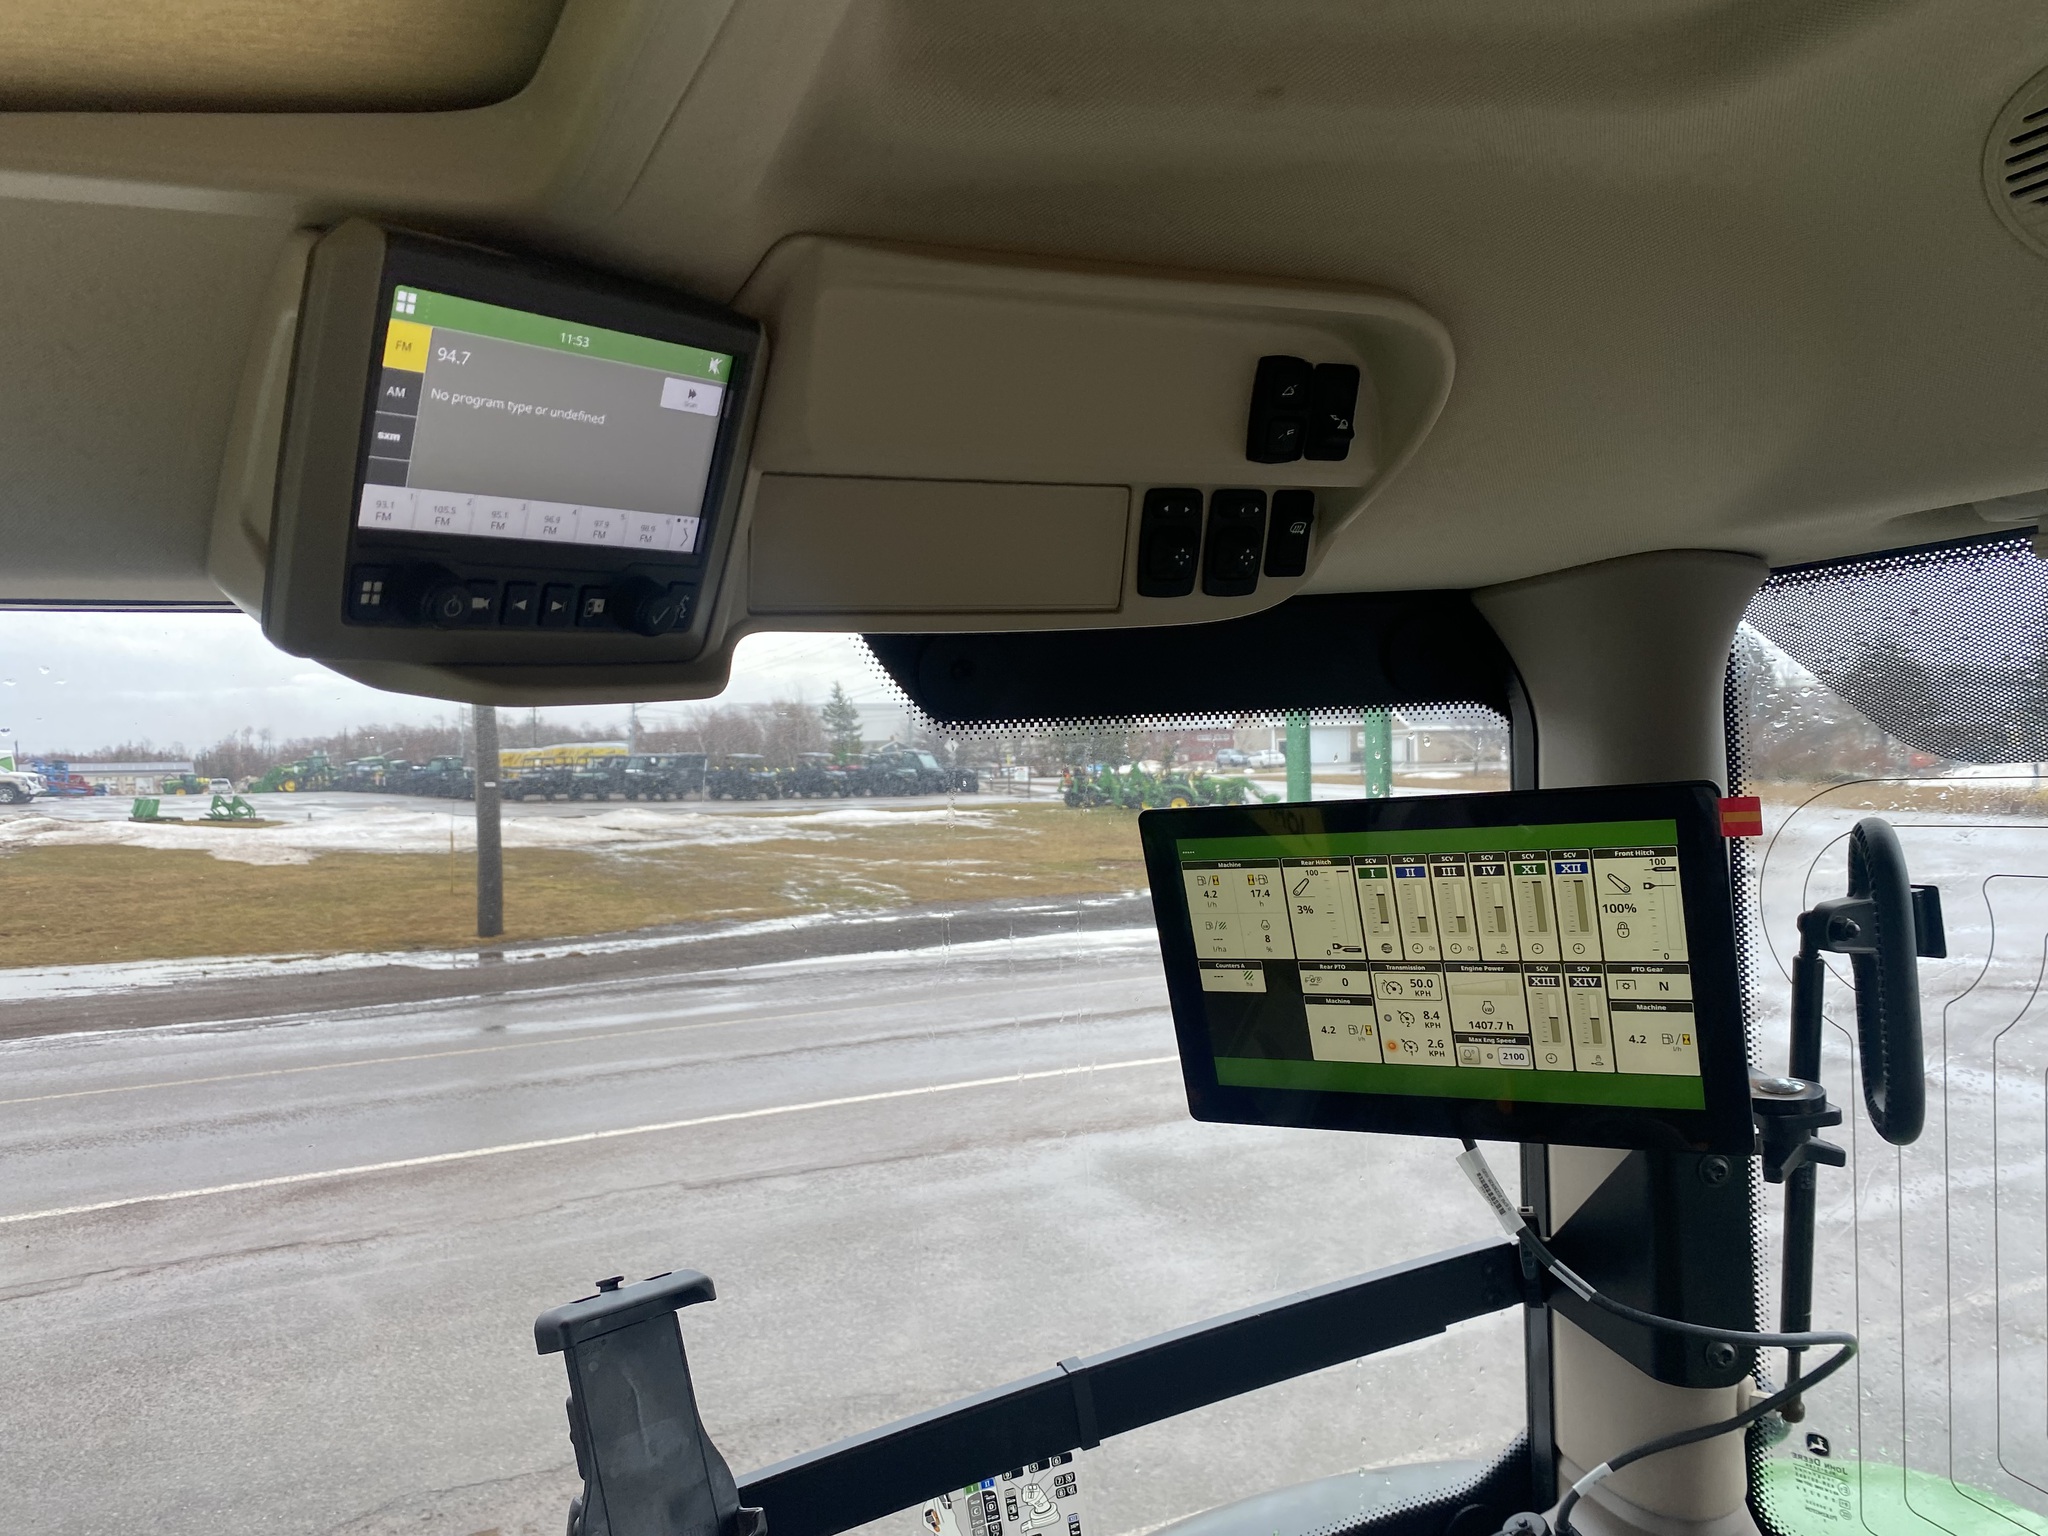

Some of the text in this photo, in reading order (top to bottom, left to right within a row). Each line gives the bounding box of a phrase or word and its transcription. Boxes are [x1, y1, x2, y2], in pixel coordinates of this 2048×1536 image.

[561, 333, 590, 348] 11:53
[395, 340, 413, 352] FM
[438, 347, 471, 366] 94.7
[386, 386, 406, 398] AM
[431, 388, 606, 425] No program type or undefined
[375, 500, 395, 510] 93.1
[433, 505, 457, 515] 105.5
[375, 511, 392, 521] FM
[434, 516, 451, 527] FM
[490, 521, 506, 531] FM
[543, 525, 557, 535] FM
[592, 530, 607, 539] FM
[639, 534, 652, 543] FM
[1305, 869, 1319, 877] 100
[1405, 868, 1416, 876] II
[1441, 867, 1457, 876] III
[1481, 866, 1496, 875] IV
[1521, 865, 1538, 874] XI
[1561, 864, 1582, 873] XII
[1203, 890, 1218, 898] 4.2
[1250, 889, 1271, 898] 17.4
[1297, 905, 1314, 915] 3%
[1602, 903, 1637, 914] 100%
[1265, 934, 1271, 943] 8
[1342, 978, 1349, 987] 0
[1410, 979, 1433, 988] 50.0
[1531, 977, 1556, 986] XIII
[1572, 978, 1598, 986] XIV
[1659, 981, 1670, 991] N
[1423, 1011, 1440, 1020] 8.4
[1321, 1026, 1336, 1034] 4.2
[1468, 1021, 1514, 1030] 1407.7 h
[1427, 1039, 1444, 1048] 2.6
[1628, 1035, 1647, 1044] 4.2
[1503, 1053, 1525, 1061] 2100
